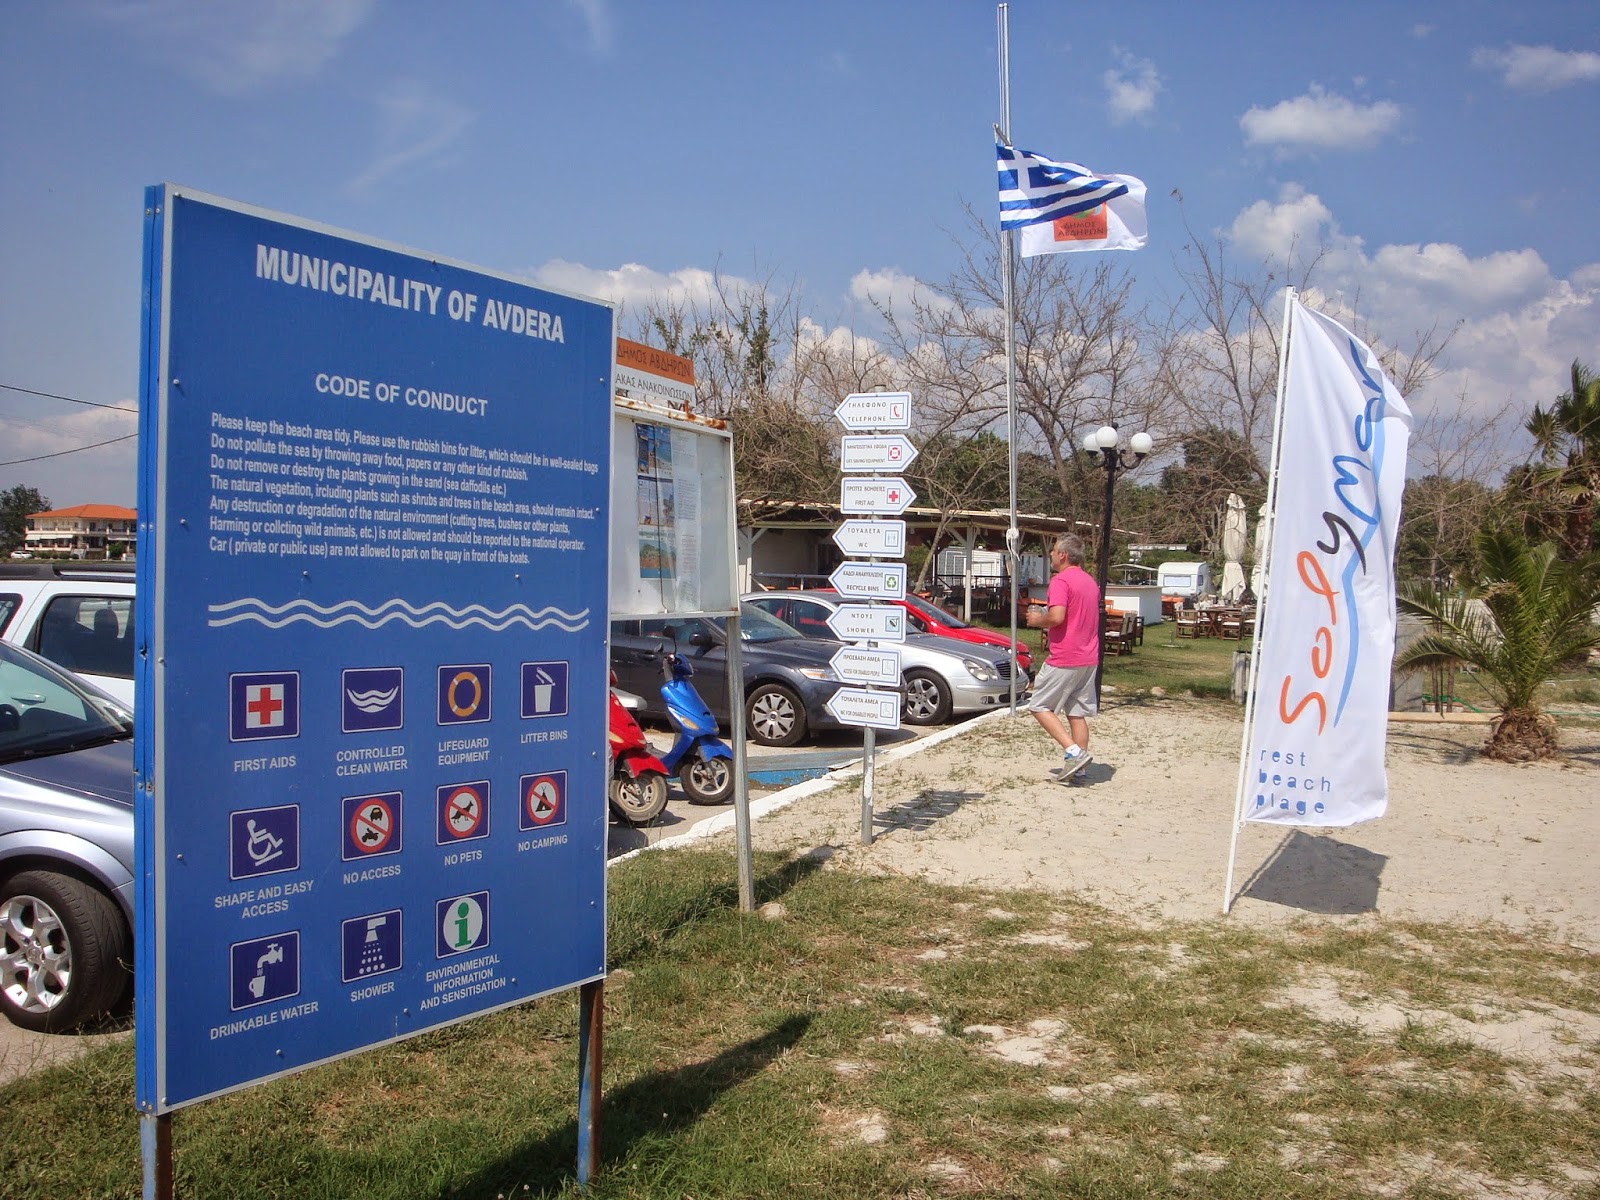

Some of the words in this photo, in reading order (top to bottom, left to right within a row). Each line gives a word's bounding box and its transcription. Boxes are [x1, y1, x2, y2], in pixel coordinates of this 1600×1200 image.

[1063, 221, 1097, 229] ΔΗΜΟΣ
[256, 244, 442, 315] MUNICIPALITY
[447, 290, 477, 322] OF
[482, 298, 564, 343] AVDERA
[617, 345, 647, 364] ΔΗΜΟΣ
[650, 352, 690, 377] ΑΒΔΗΡΩΝ
[616, 373, 635, 387] ΑΚΑΣ
[315, 373, 370, 399] CODE
[375, 382, 400, 403] OF
[405, 387, 488, 416] CONDUCT
[211, 412, 243, 430] Please
[245, 416, 268, 436] keep
[269, 420, 284, 435] the
[285, 421, 312, 438] beach
[313, 428, 333, 440] area
[353, 430, 380, 446] Please
[381, 437, 396, 448] use
[397, 436, 410, 450] the
[411, 438, 440, 453] rubbish
[441, 440, 457, 455] bins
[457, 443, 469, 456] for
[488, 448, 509, 461] which
[509, 450, 532, 464] should
[532, 453, 541, 466] be
[542, 454, 549, 466] in
[549, 456, 583, 471] well-sealed
[583, 460, 598, 475] bags
[211, 432, 225, 448] Do
[227, 437, 243, 450] not
[244, 438, 276, 454] pollute
[277, 441, 293, 455] the
[294, 445, 310, 457] sea
[311, 444, 323, 462] by
[324, 446, 361, 466] throwing
[362, 453, 383, 468] away
[405, 458, 432, 471] papers
[432, 460, 441, 471] or
[442, 461, 456, 475] any
[456, 461, 476, 474] other
[476, 463, 492, 476] kind
[492, 465, 501, 478] of
[210, 453, 225, 469] Do
[226, 457, 243, 471] not
[244, 460, 279, 474] remove
[280, 463, 291, 475] or
[292, 462, 325, 481] destroy
[326, 465, 340, 480] the
[341, 467, 367, 483] plants
[368, 471, 400, 488] growing
[401, 472, 409, 486] in
[410, 473, 423, 487] the
[424, 476, 442, 489] sand
[460, 478, 490, 493] daffodils
[210, 474, 229, 490] The
[230, 478, 263, 492] natural
[353, 487, 379, 503] plants
[380, 490, 399, 503] such
[400, 493, 410, 504] as
[411, 492, 438, 506] shrubs
[438, 495, 453, 507] and
[453, 496, 472, 509] trees
[472, 497, 480, 509] in
[481, 498, 493, 511] the
[493, 499, 514, 513] beach
[531, 503, 554, 516] should
[554, 506, 575, 518] remain
[209, 515, 250, 536] Harming
[251, 521, 263, 532] or
[303, 521, 322, 536] wild
[378, 526, 386, 539] is
[387, 528, 401, 540] not
[402, 527, 431, 541] allowed
[432, 530, 446, 542] and
[447, 530, 472, 544] should
[472, 531, 482, 544] be
[482, 534, 511, 547] reported
[512, 535, 520, 547] to
[520, 535, 531, 547] the
[532, 536, 557, 548] national
[438, 737, 489, 752] LIFEGUARD
[520, 731, 548, 743] LITTER
[549, 730, 568, 741] BINS
[234, 758, 267, 772] FIRST
[269, 755, 296, 769] AIDS
[336, 745, 405, 762] CONTROLLED
[438, 750, 490, 765] EQUIPMENT
[1260, 750, 1306, 766] rest
[336, 762, 371, 776] CLEAN
[373, 759, 407, 772] WATER
[1259, 768, 1331, 792] beach
[1256, 793, 1325, 815] plage
[518, 841, 530, 852] NO
[531, 834, 568, 849] CAMPING
[444, 854, 458, 866] NO
[459, 849, 482, 863] PETS
[343, 872, 359, 884] NO
[360, 864, 401, 881] ACCESS
[214, 890, 255, 908] SHAPE
[257, 886, 281, 900] AND
[284, 880, 314, 895] EASY
[241, 899, 288, 918] ACCESS
[426, 954, 500, 982] ENVIRONMENTAL
[433, 967, 493, 993] INFORMATION
[350, 981, 394, 1002] SHOWER
[420, 996, 440, 1010] AND
[442, 977, 505, 1004] SENSITISATION
[210, 1011, 277, 1040] DRINKABLE
[280, 1001, 318, 1020] WATER
